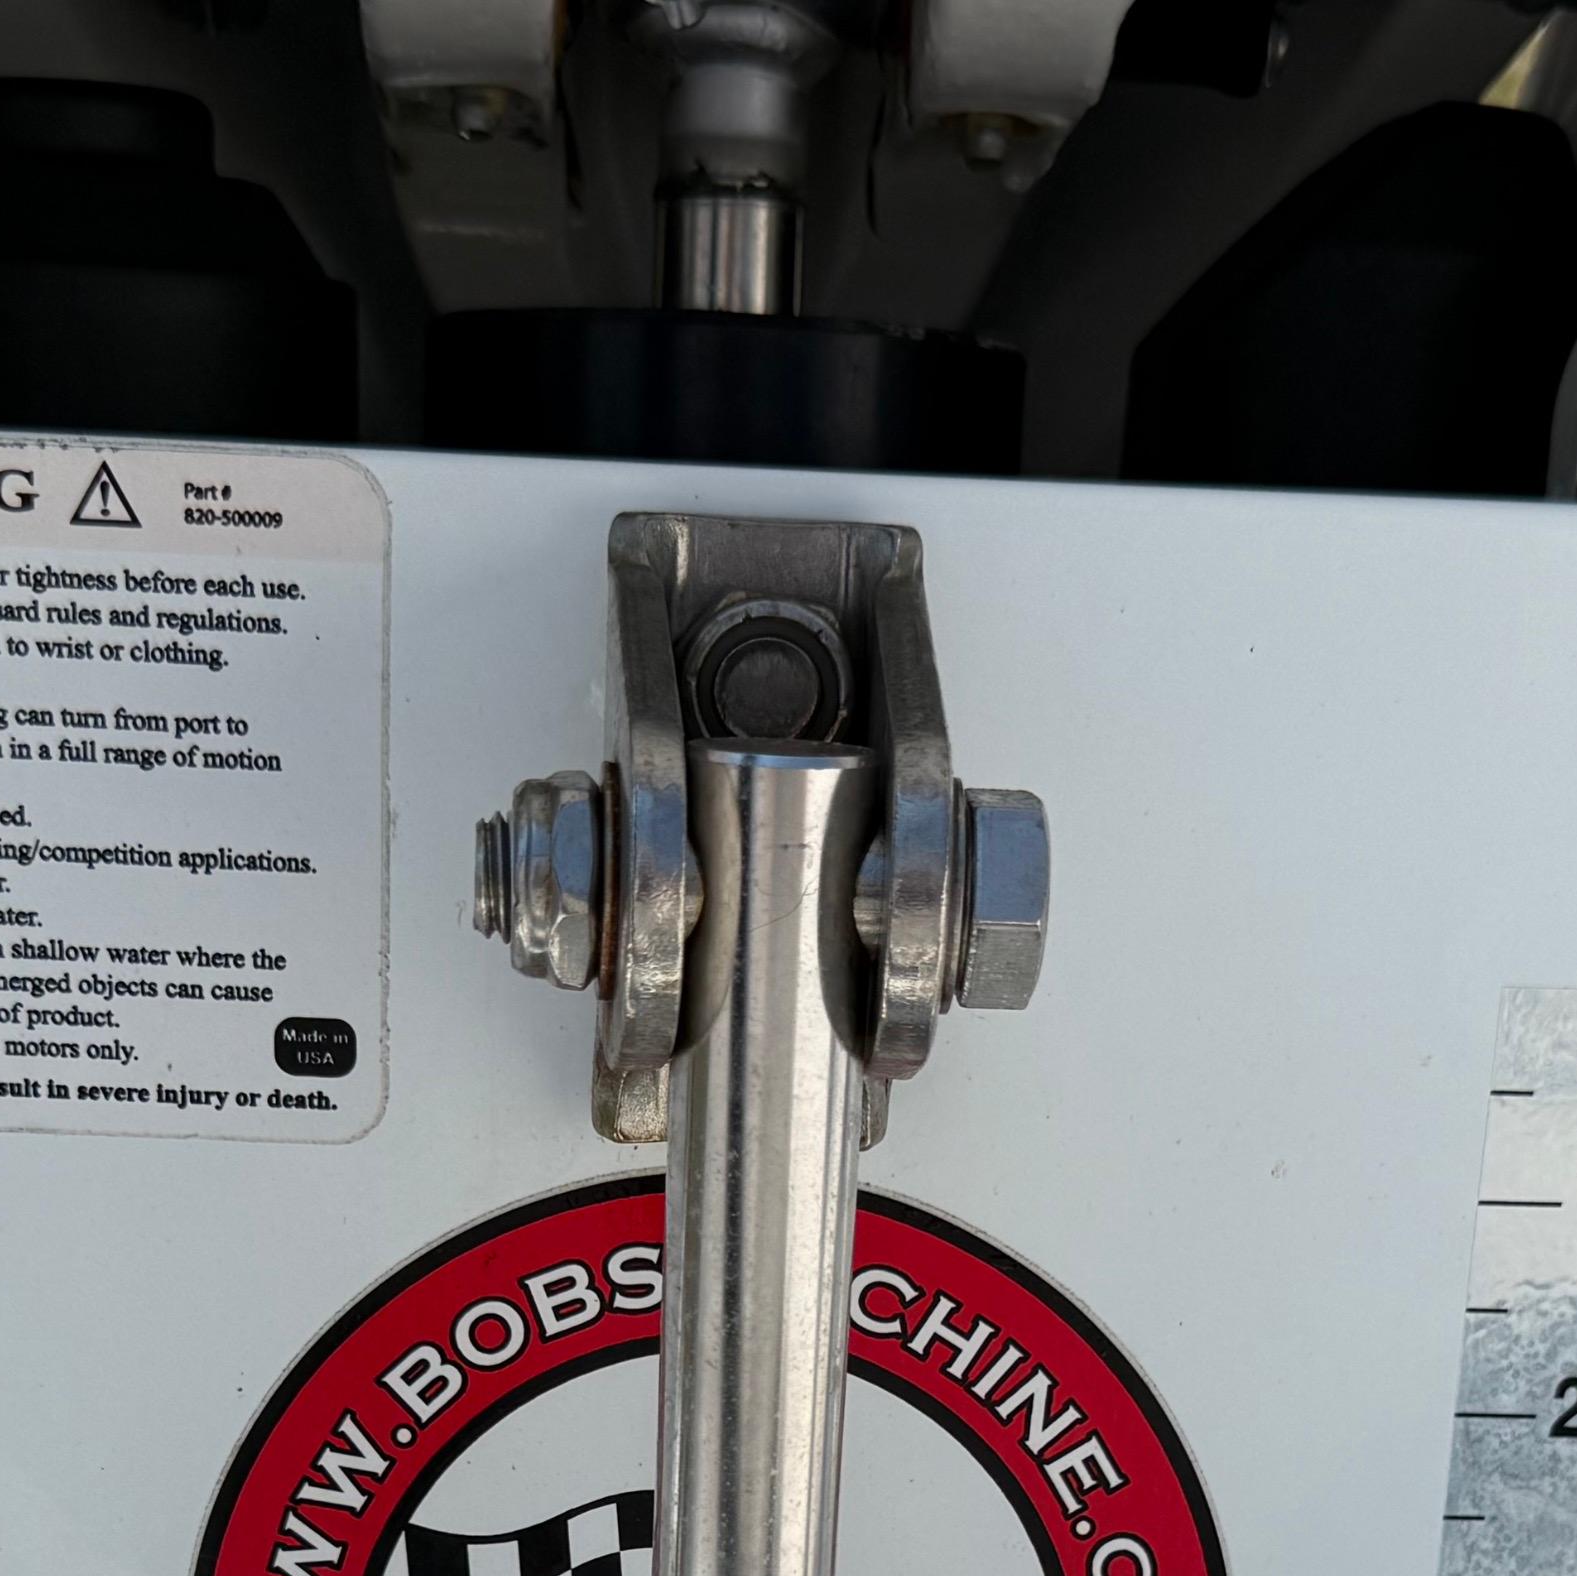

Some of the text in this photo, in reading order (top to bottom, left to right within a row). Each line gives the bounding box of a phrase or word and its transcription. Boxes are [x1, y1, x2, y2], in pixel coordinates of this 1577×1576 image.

[184, 481, 219, 501] Part
[184, 507, 283, 529] 820-500009
[14, 563, 119, 595] tightness
[122, 568, 198, 596] before
[203, 573, 256, 599] each
[260, 580, 306, 602] use.
[45, 600, 103, 627] rules
[108, 603, 152, 629] and
[155, 607, 288, 637] regulations.
[13, 707, 56, 728] can
[59, 706, 108, 730] turn
[113, 705, 170, 734] from
[173, 714, 222, 741] port
[225, 715, 249, 738] to
[177, 846, 318, 877] applications.
[10, 936, 101, 963] shallow
[105, 945, 172, 967] water
[175, 944, 246, 970] where
[251, 946, 287, 972] the
[3, 1038, 81, 1060] motors
[85, 1037, 139, 1067] only.
[297, 1050, 335, 1065] USA
[46, 1077, 71, 1101] in
[76, 1084, 151, 1104] severe
[155, 1082, 230, 1112] injury
[234, 1091, 262, 1108] or
[266, 1087, 338, 1112] death.
